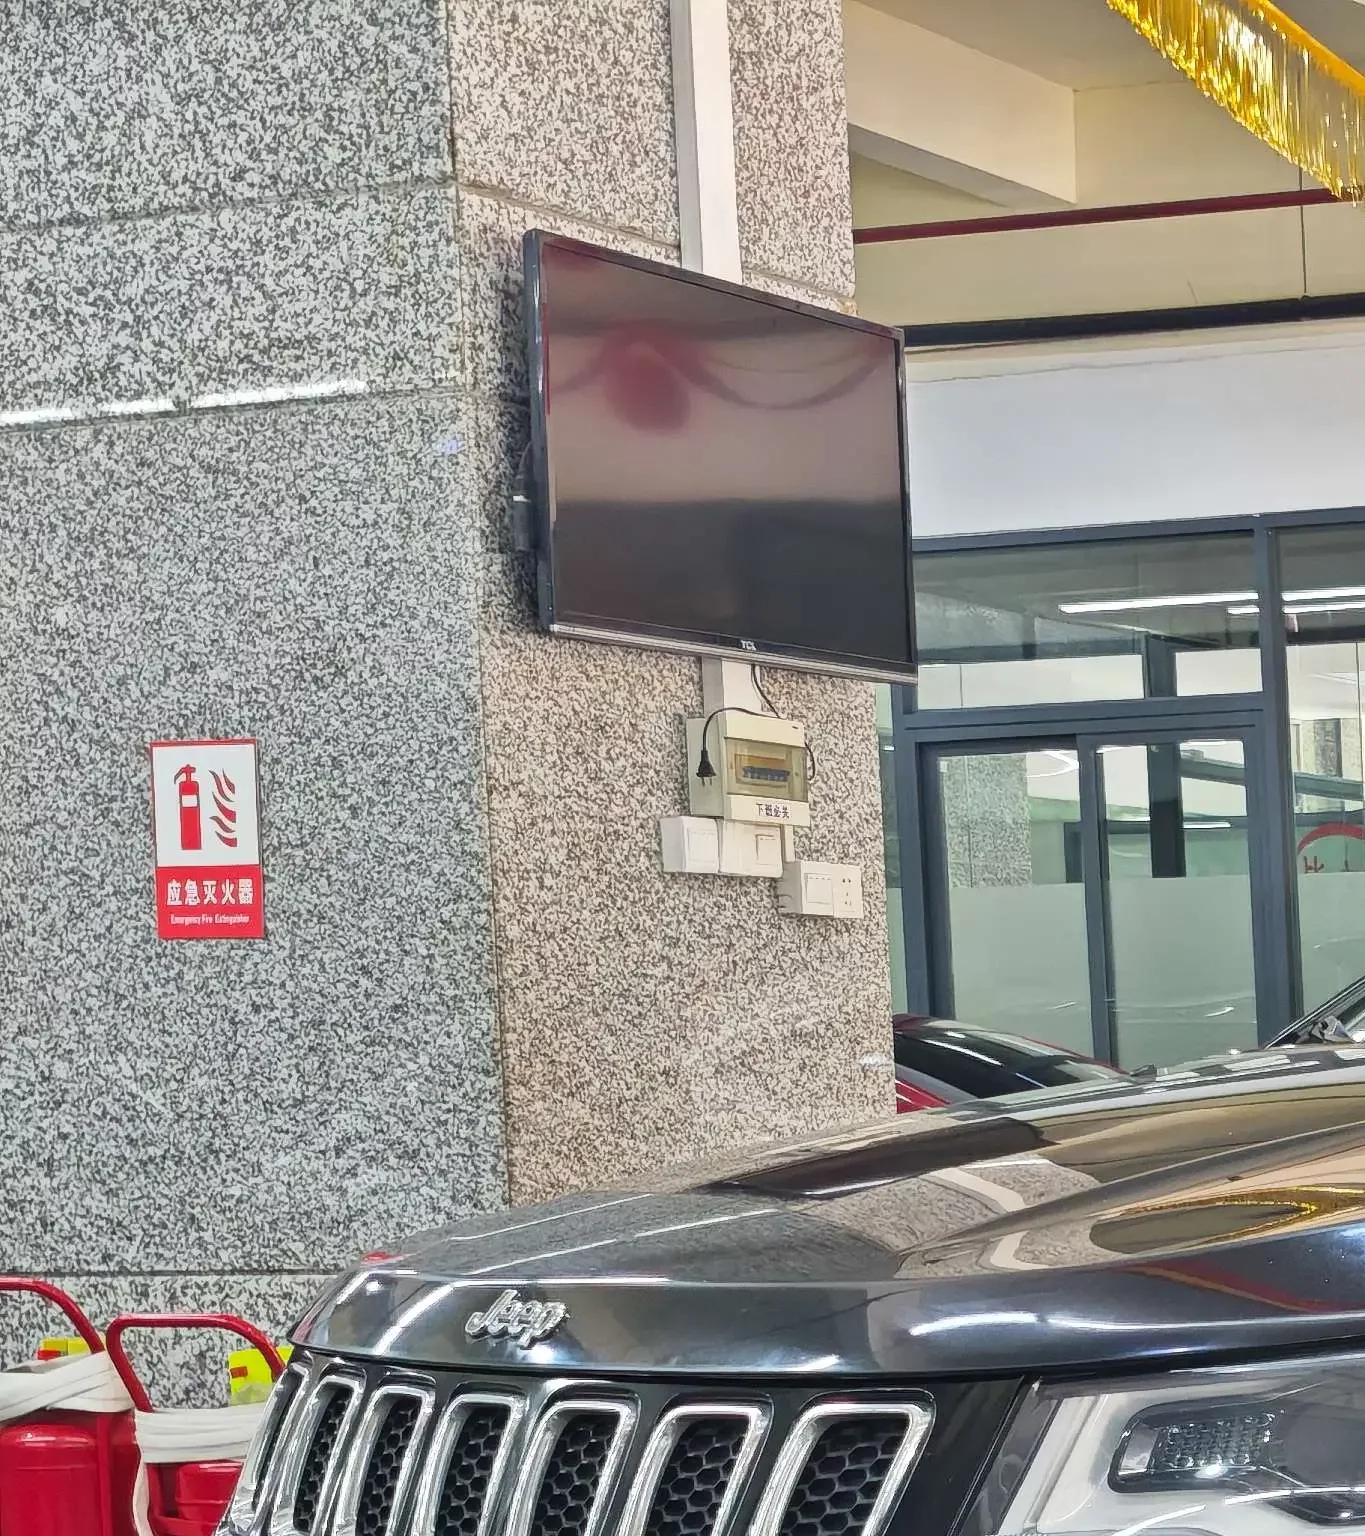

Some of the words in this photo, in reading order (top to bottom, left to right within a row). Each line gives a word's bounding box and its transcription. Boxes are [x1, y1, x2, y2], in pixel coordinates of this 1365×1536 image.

[167, 879, 254, 905] 应急灭火器
[465, 1289, 569, 1350] Jeep
